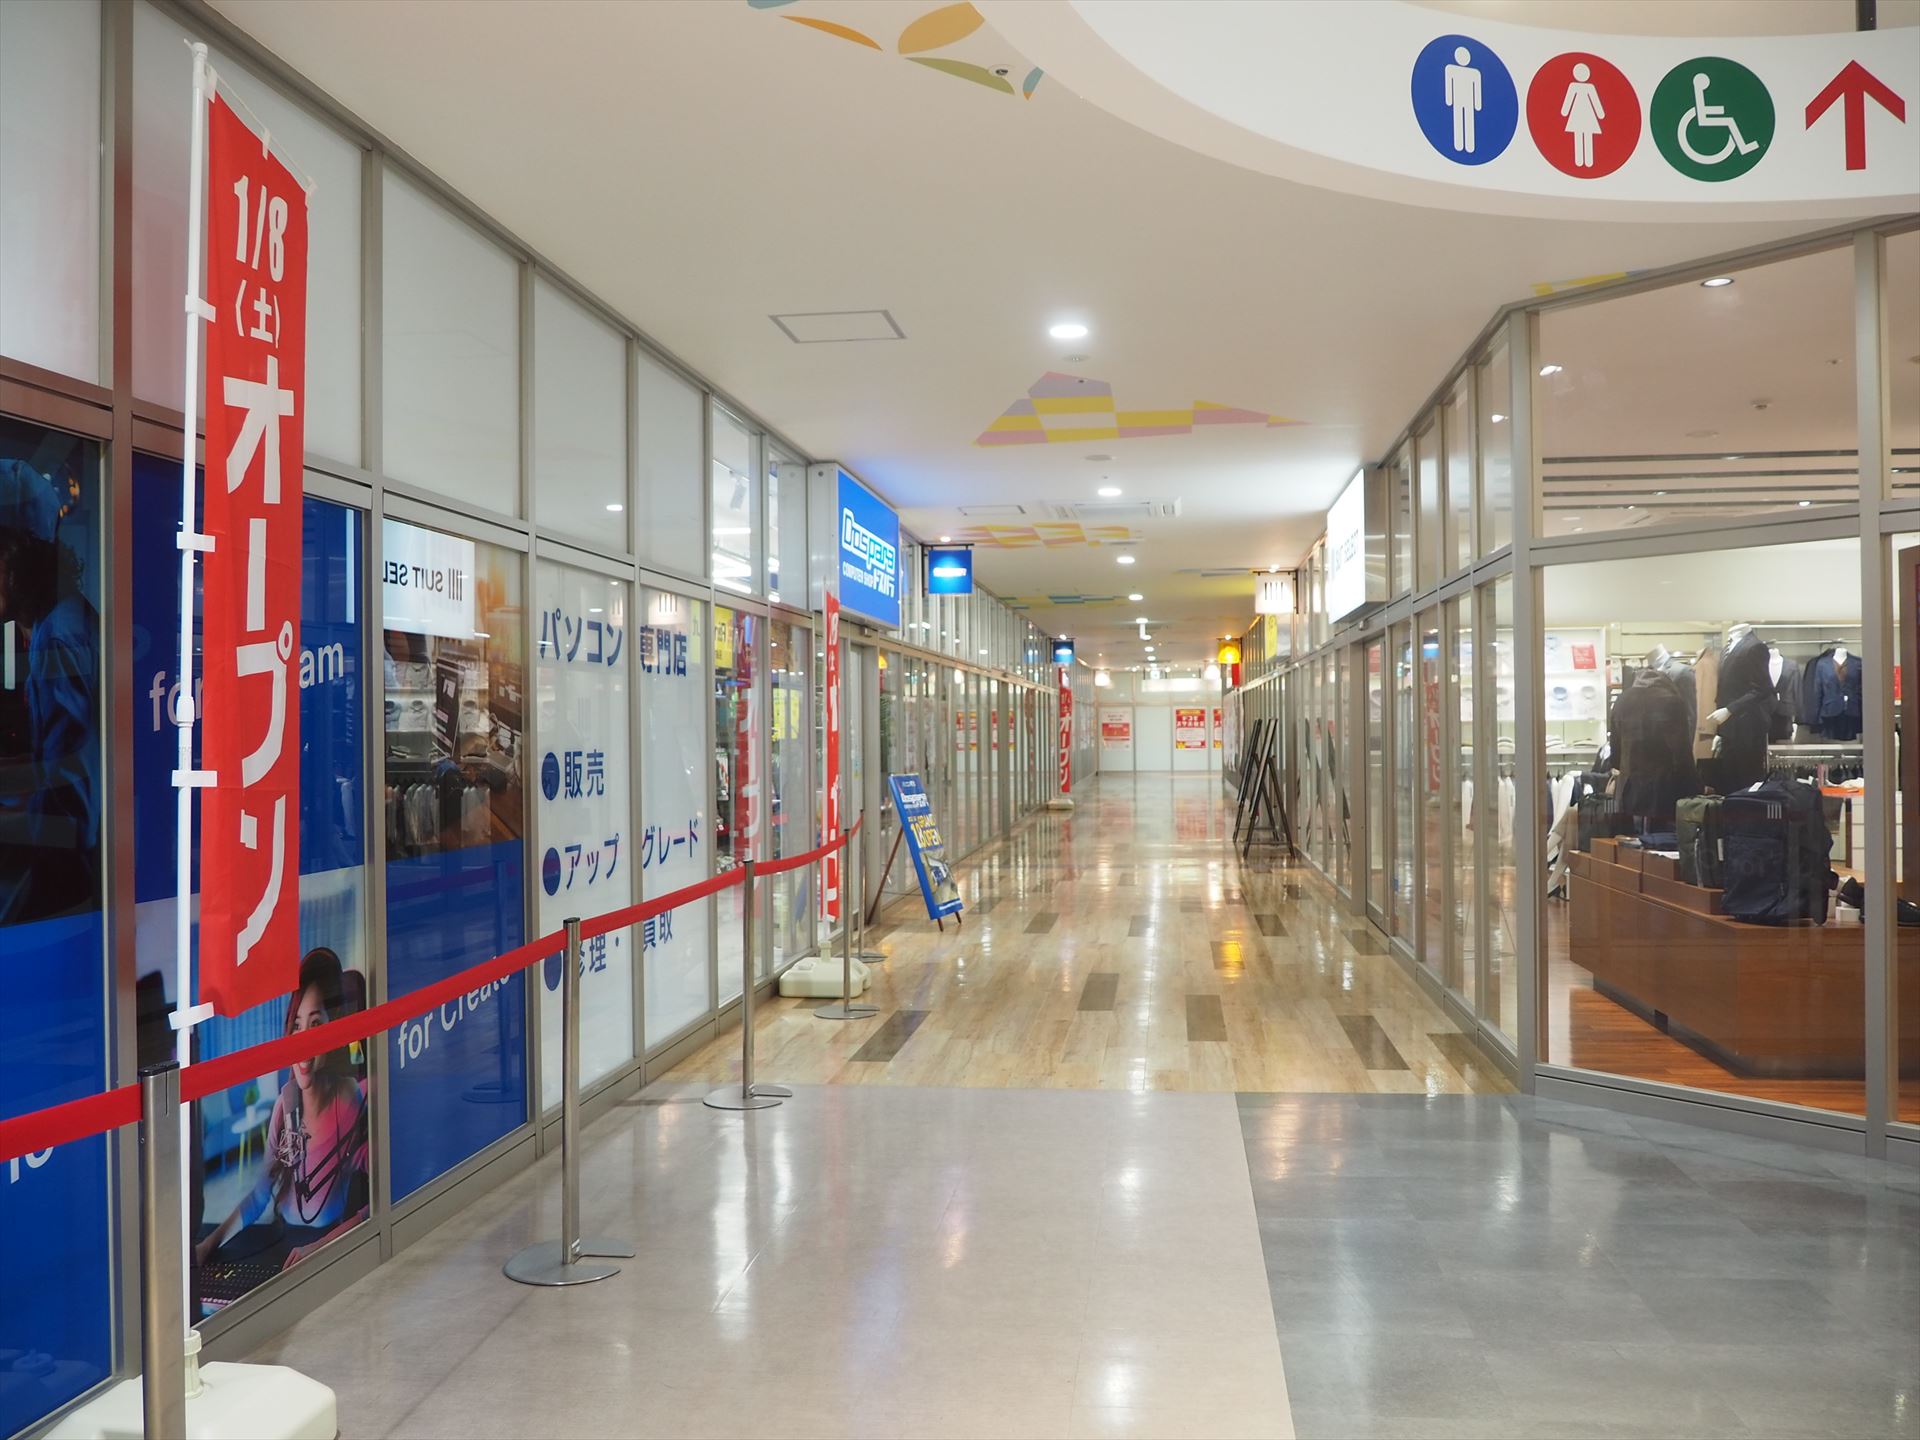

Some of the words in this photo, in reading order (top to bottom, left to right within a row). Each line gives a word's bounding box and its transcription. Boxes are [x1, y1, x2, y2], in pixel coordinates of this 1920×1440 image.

[233, 174, 289, 283] 1/8
[234, 279, 282, 349] (土)
[223, 353, 295, 968] オープン
[564, 749, 605, 800] 販売
[398, 1012, 434, 1070] for
